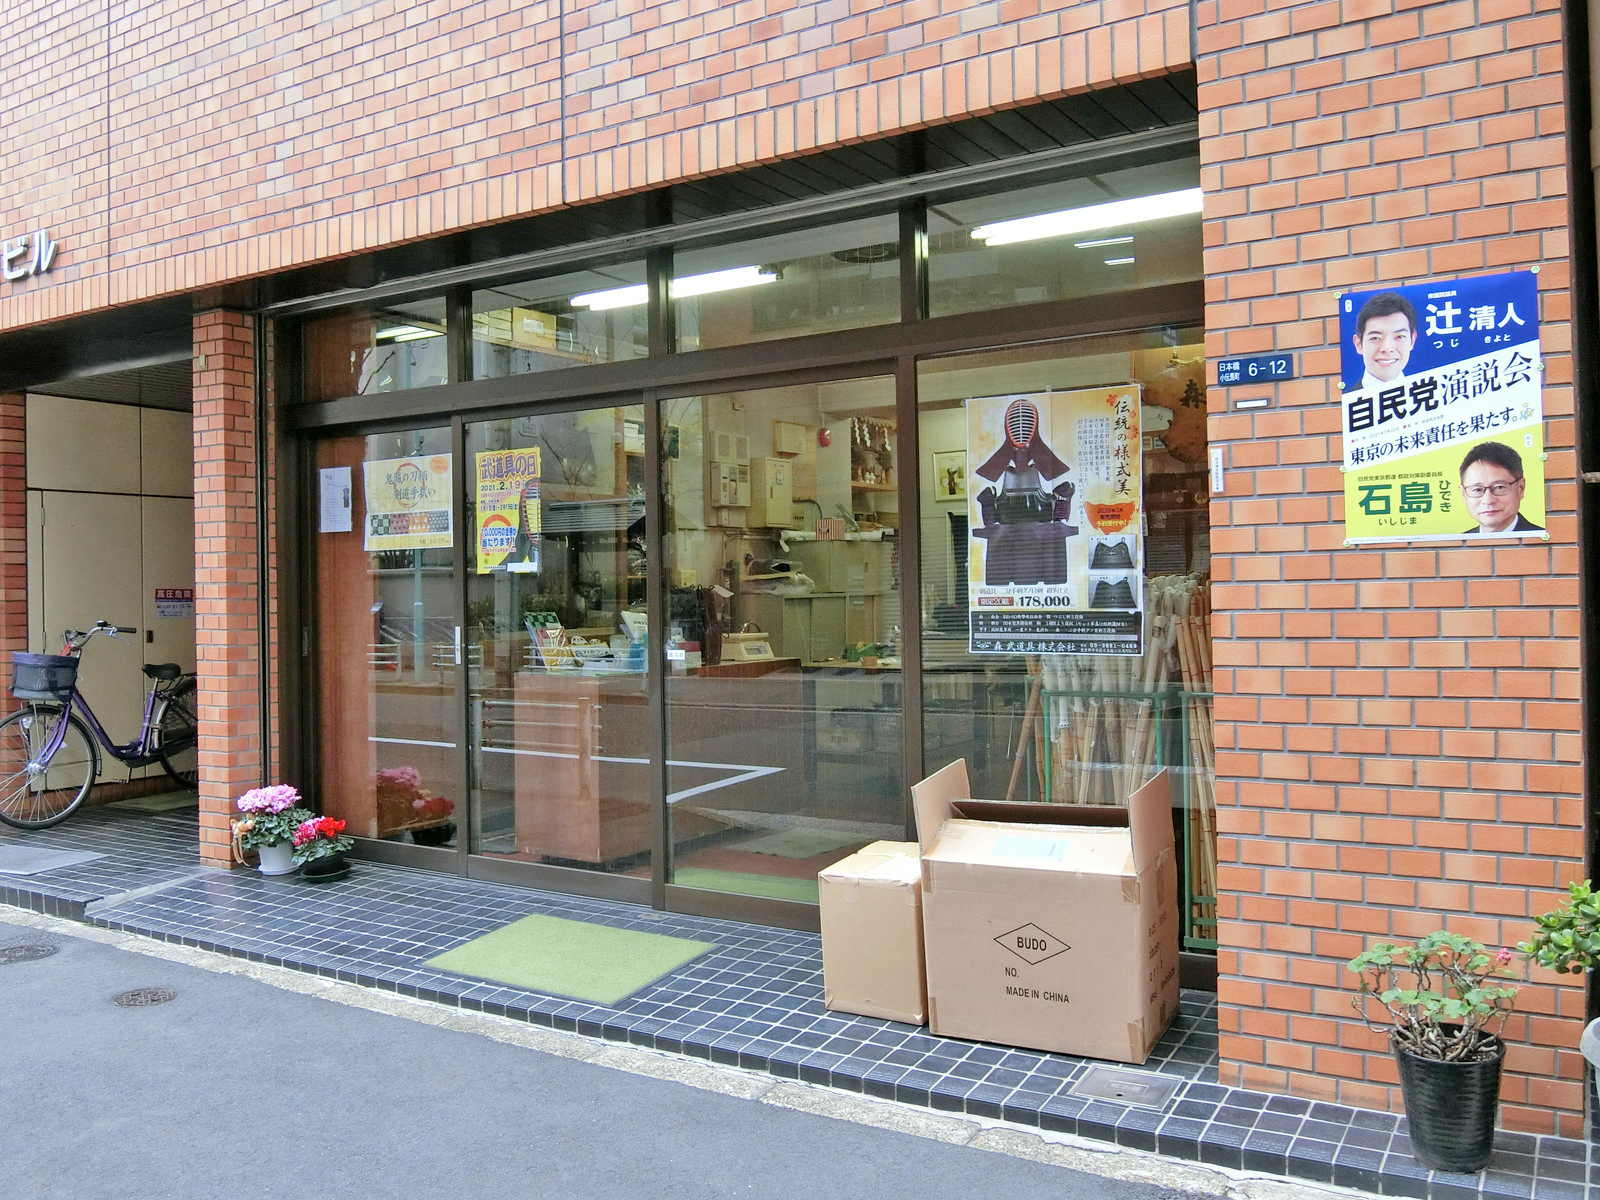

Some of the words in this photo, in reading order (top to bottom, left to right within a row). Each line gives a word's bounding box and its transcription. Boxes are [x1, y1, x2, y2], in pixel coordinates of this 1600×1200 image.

[4, 228, 58, 280] ビル
[1425, 300, 1463, 337] 辻
[1468, 302, 1526, 332] 清人
[1433, 338, 1460, 350] つじ
[1484, 333, 1511, 344] きよと
[1219, 361, 1240, 372] 日本橋
[1248, 360, 1287, 377] 6-12
[1219, 372, 1240, 382] 小伝馬町
[1348, 351, 1533, 433] 自民党演説会
[1350, 407, 1517, 466] 東京の未来責任を果たす。
[1113, 400, 1131, 496] 伝統の様式美
[480, 454, 537, 480] 武道具の日
[386, 470, 428, 485] 鬼滅の刃柄
[1358, 482, 1433, 516] 石島
[1439, 480, 1452, 513] ひでき
[1378, 516, 1417, 526] いしじま
[157, 590, 191, 598] 高圧危険
[1017, 936, 1047, 951] BUDO
[1005, 967, 1020, 978] NO.
[1006, 986, 1030, 998] MADE
[1031, 989, 1040, 999] IN
[1043, 991, 1070, 1003] CHINA
